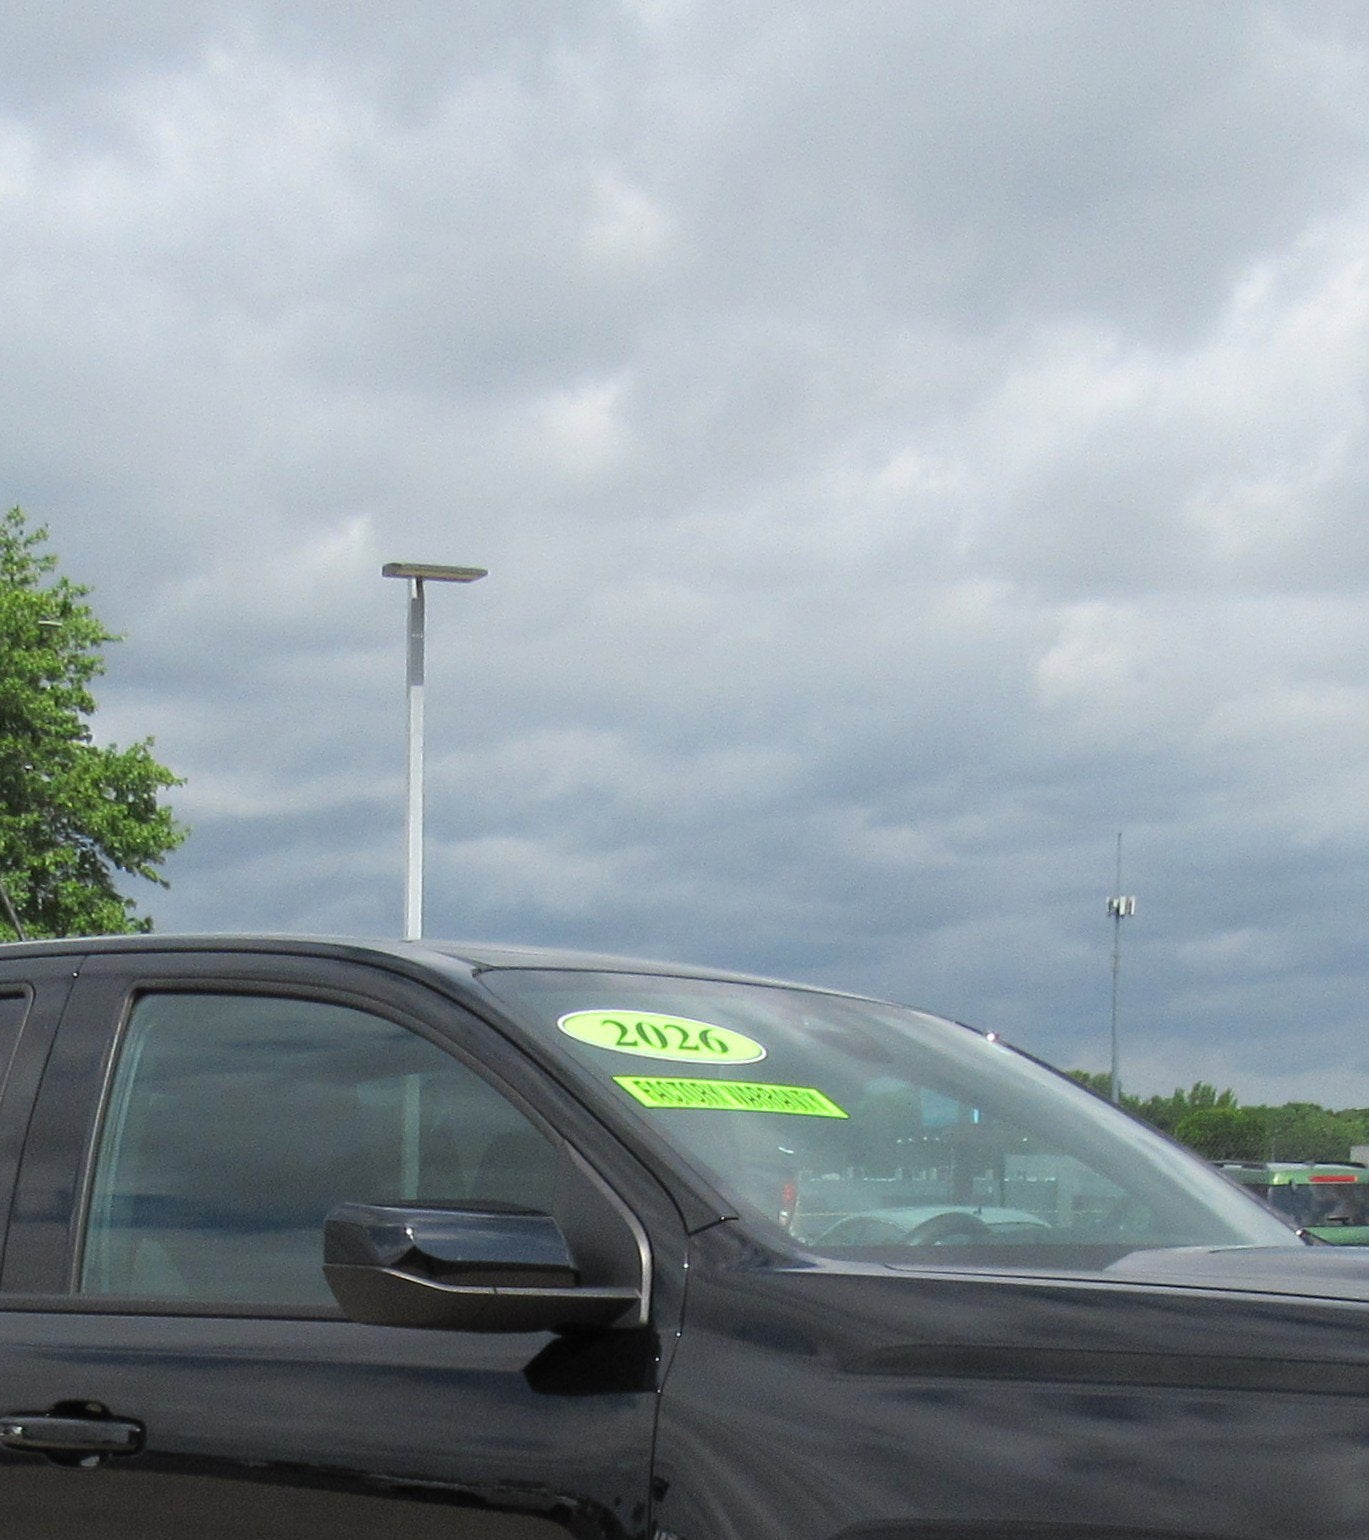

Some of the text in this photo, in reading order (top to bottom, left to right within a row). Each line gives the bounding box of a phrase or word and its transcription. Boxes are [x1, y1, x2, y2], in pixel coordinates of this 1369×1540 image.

[602, 1020, 728, 1053] 2026
[630, 1080, 831, 1111] FACTORY WARRANTY
